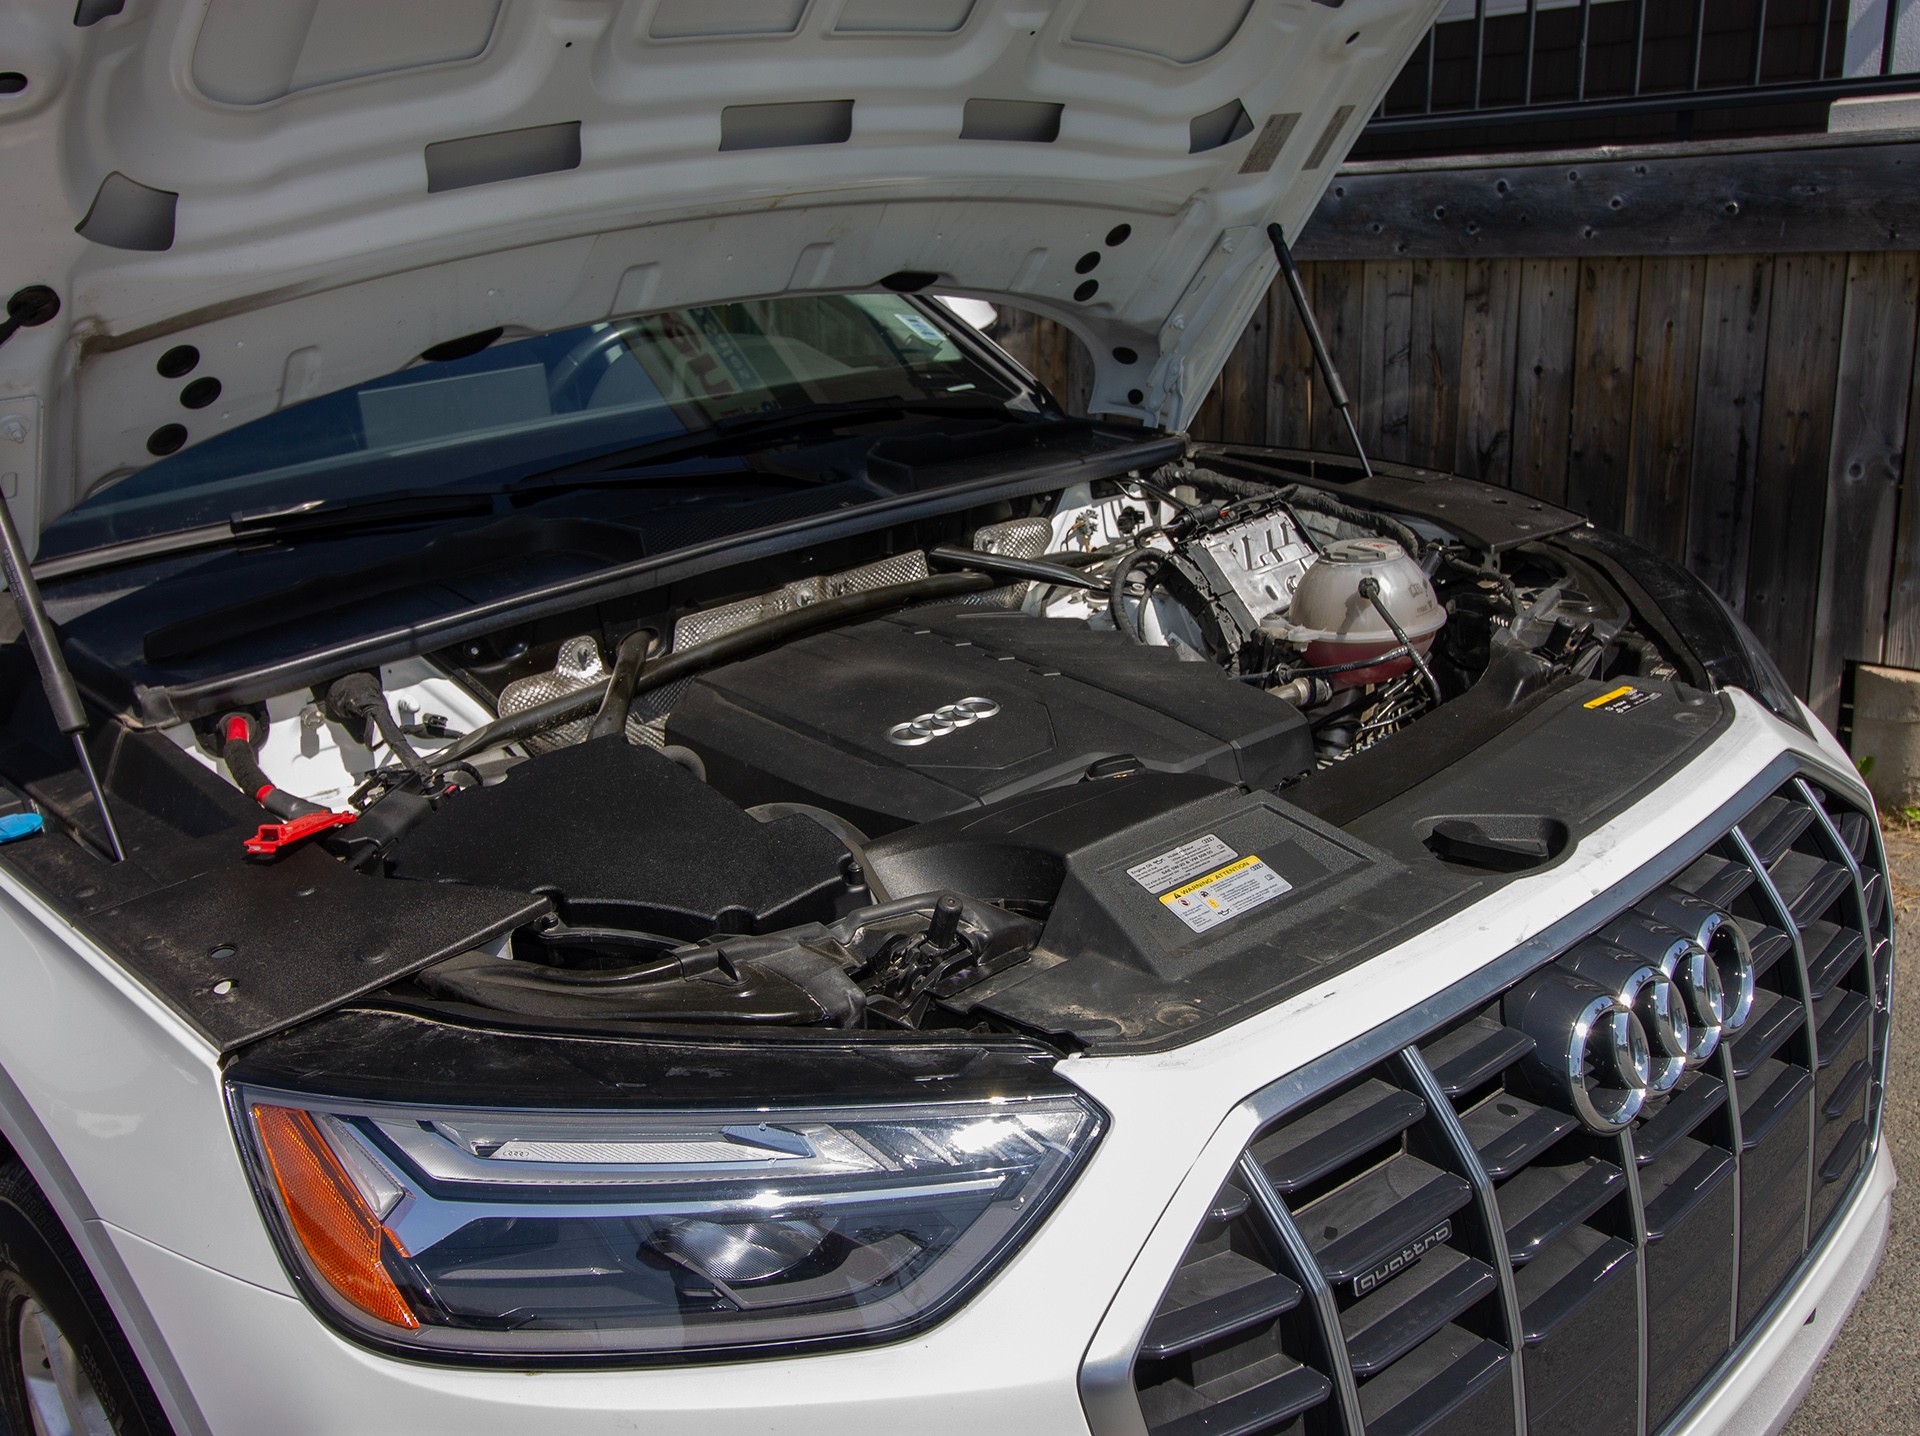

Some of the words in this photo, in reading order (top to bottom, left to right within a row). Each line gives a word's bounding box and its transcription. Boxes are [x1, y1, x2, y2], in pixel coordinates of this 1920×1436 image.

[1131, 866, 1146, 875] Engine
[1180, 877, 1214, 896] WARNING
[1214, 860, 1250, 880] ATTENTION
[1361, 1226, 1449, 1290] quattro
